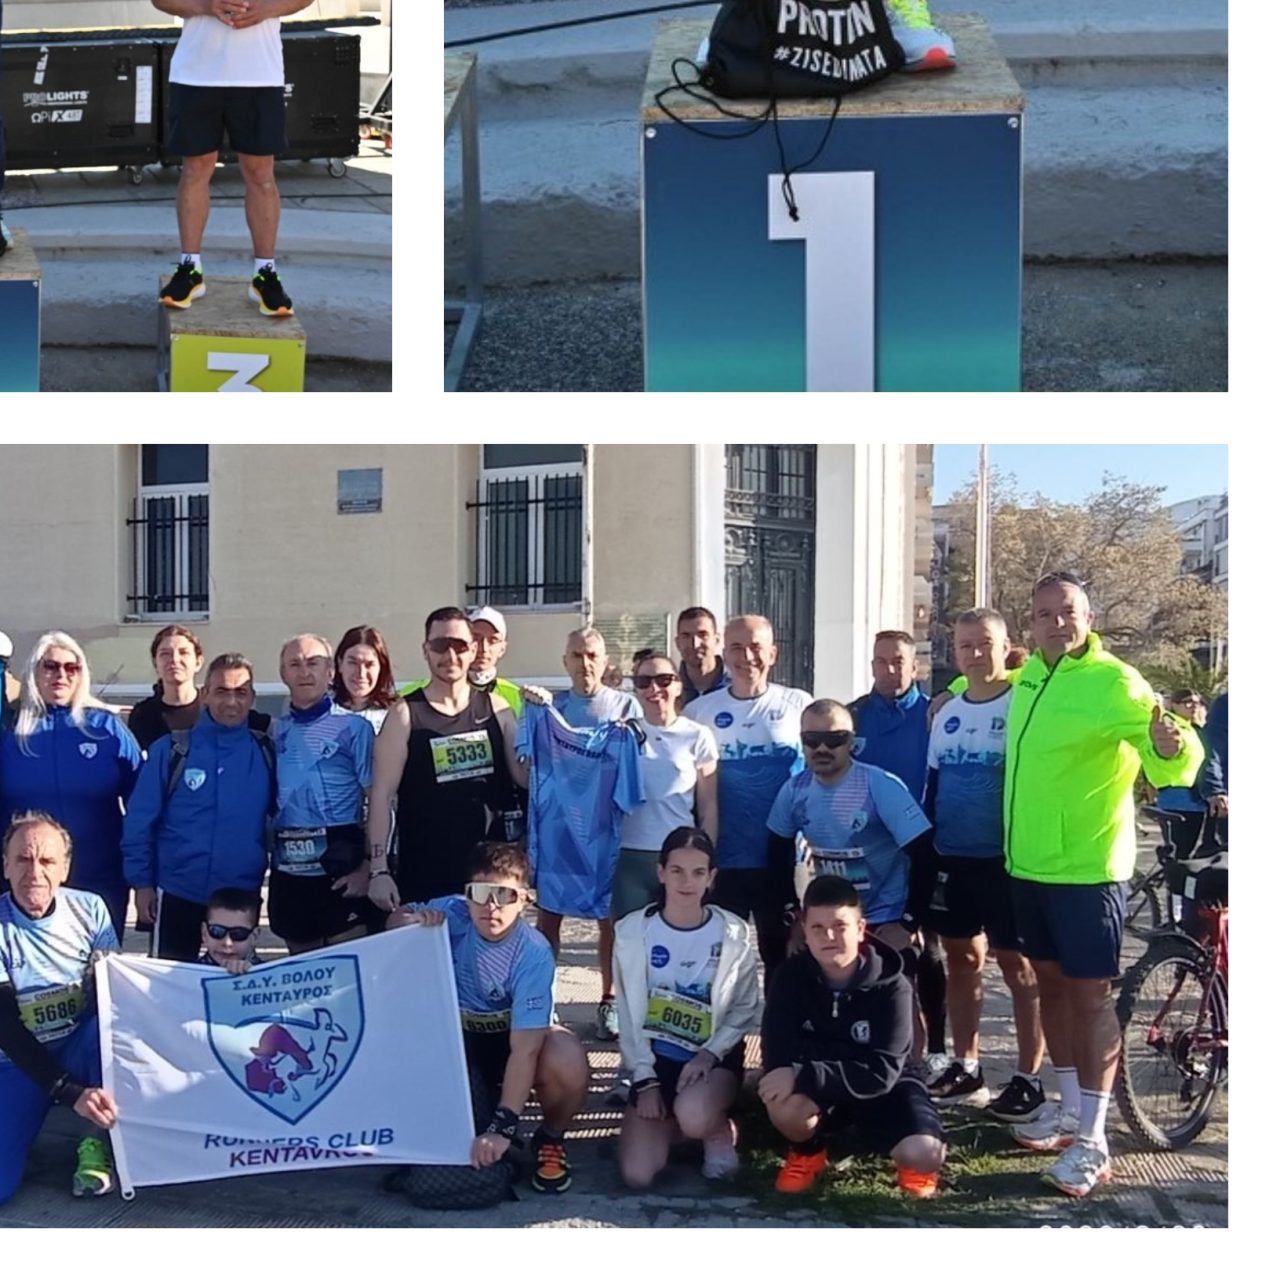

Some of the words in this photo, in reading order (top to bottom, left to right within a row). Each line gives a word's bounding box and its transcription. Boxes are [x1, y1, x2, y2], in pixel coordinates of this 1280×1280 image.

[446, 742, 487, 765] 5333
[284, 839, 315, 856] 1530
[232, 976, 277, 991] Σ.Δ.Υ.
[281, 966, 336, 985] ΒΟΛΟΥ
[241, 985, 333, 1007] ΚΕΝΤΑΥΡΟΣ
[33, 999, 77, 1024] 5686
[662, 1006, 703, 1034] 6035
[327, 1128, 395, 1149] CLUB
